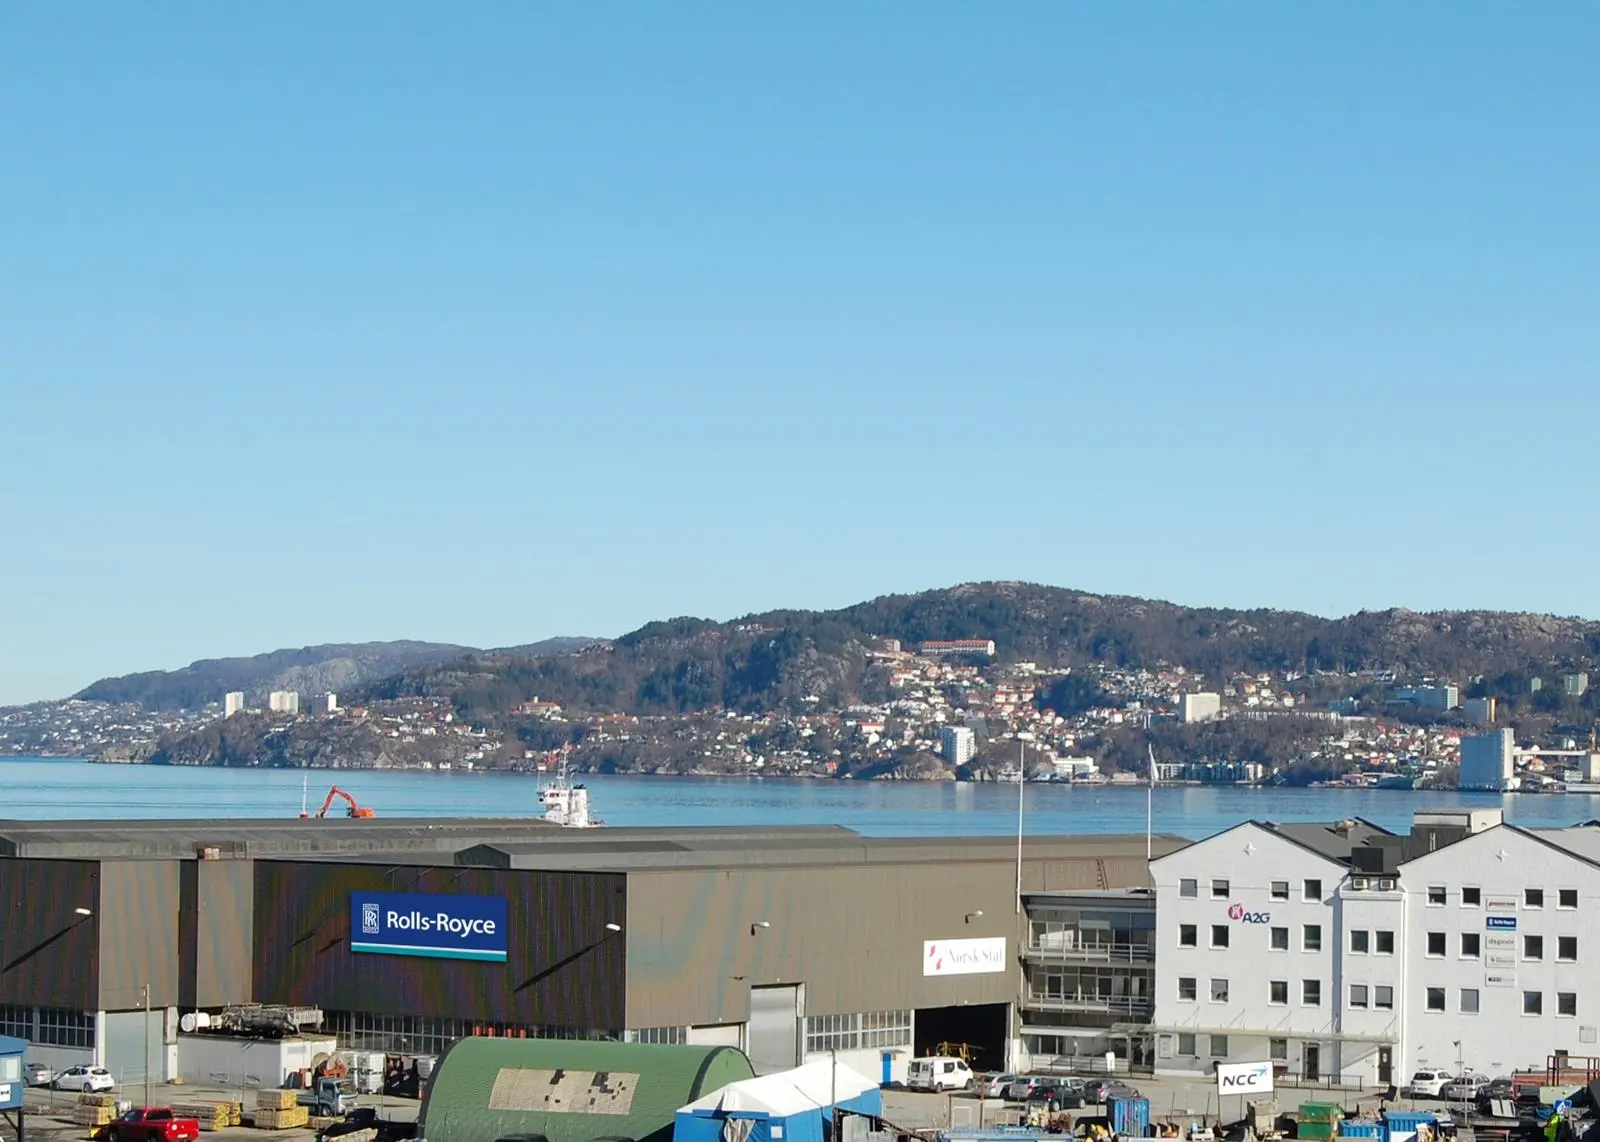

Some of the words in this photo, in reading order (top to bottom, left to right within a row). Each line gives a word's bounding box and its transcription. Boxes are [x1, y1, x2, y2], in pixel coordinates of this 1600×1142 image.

[387, 911, 496, 938] Rolls-Royce
[1242, 911, 1271, 924] A2G
[1222, 1073, 1258, 1087] NCC
